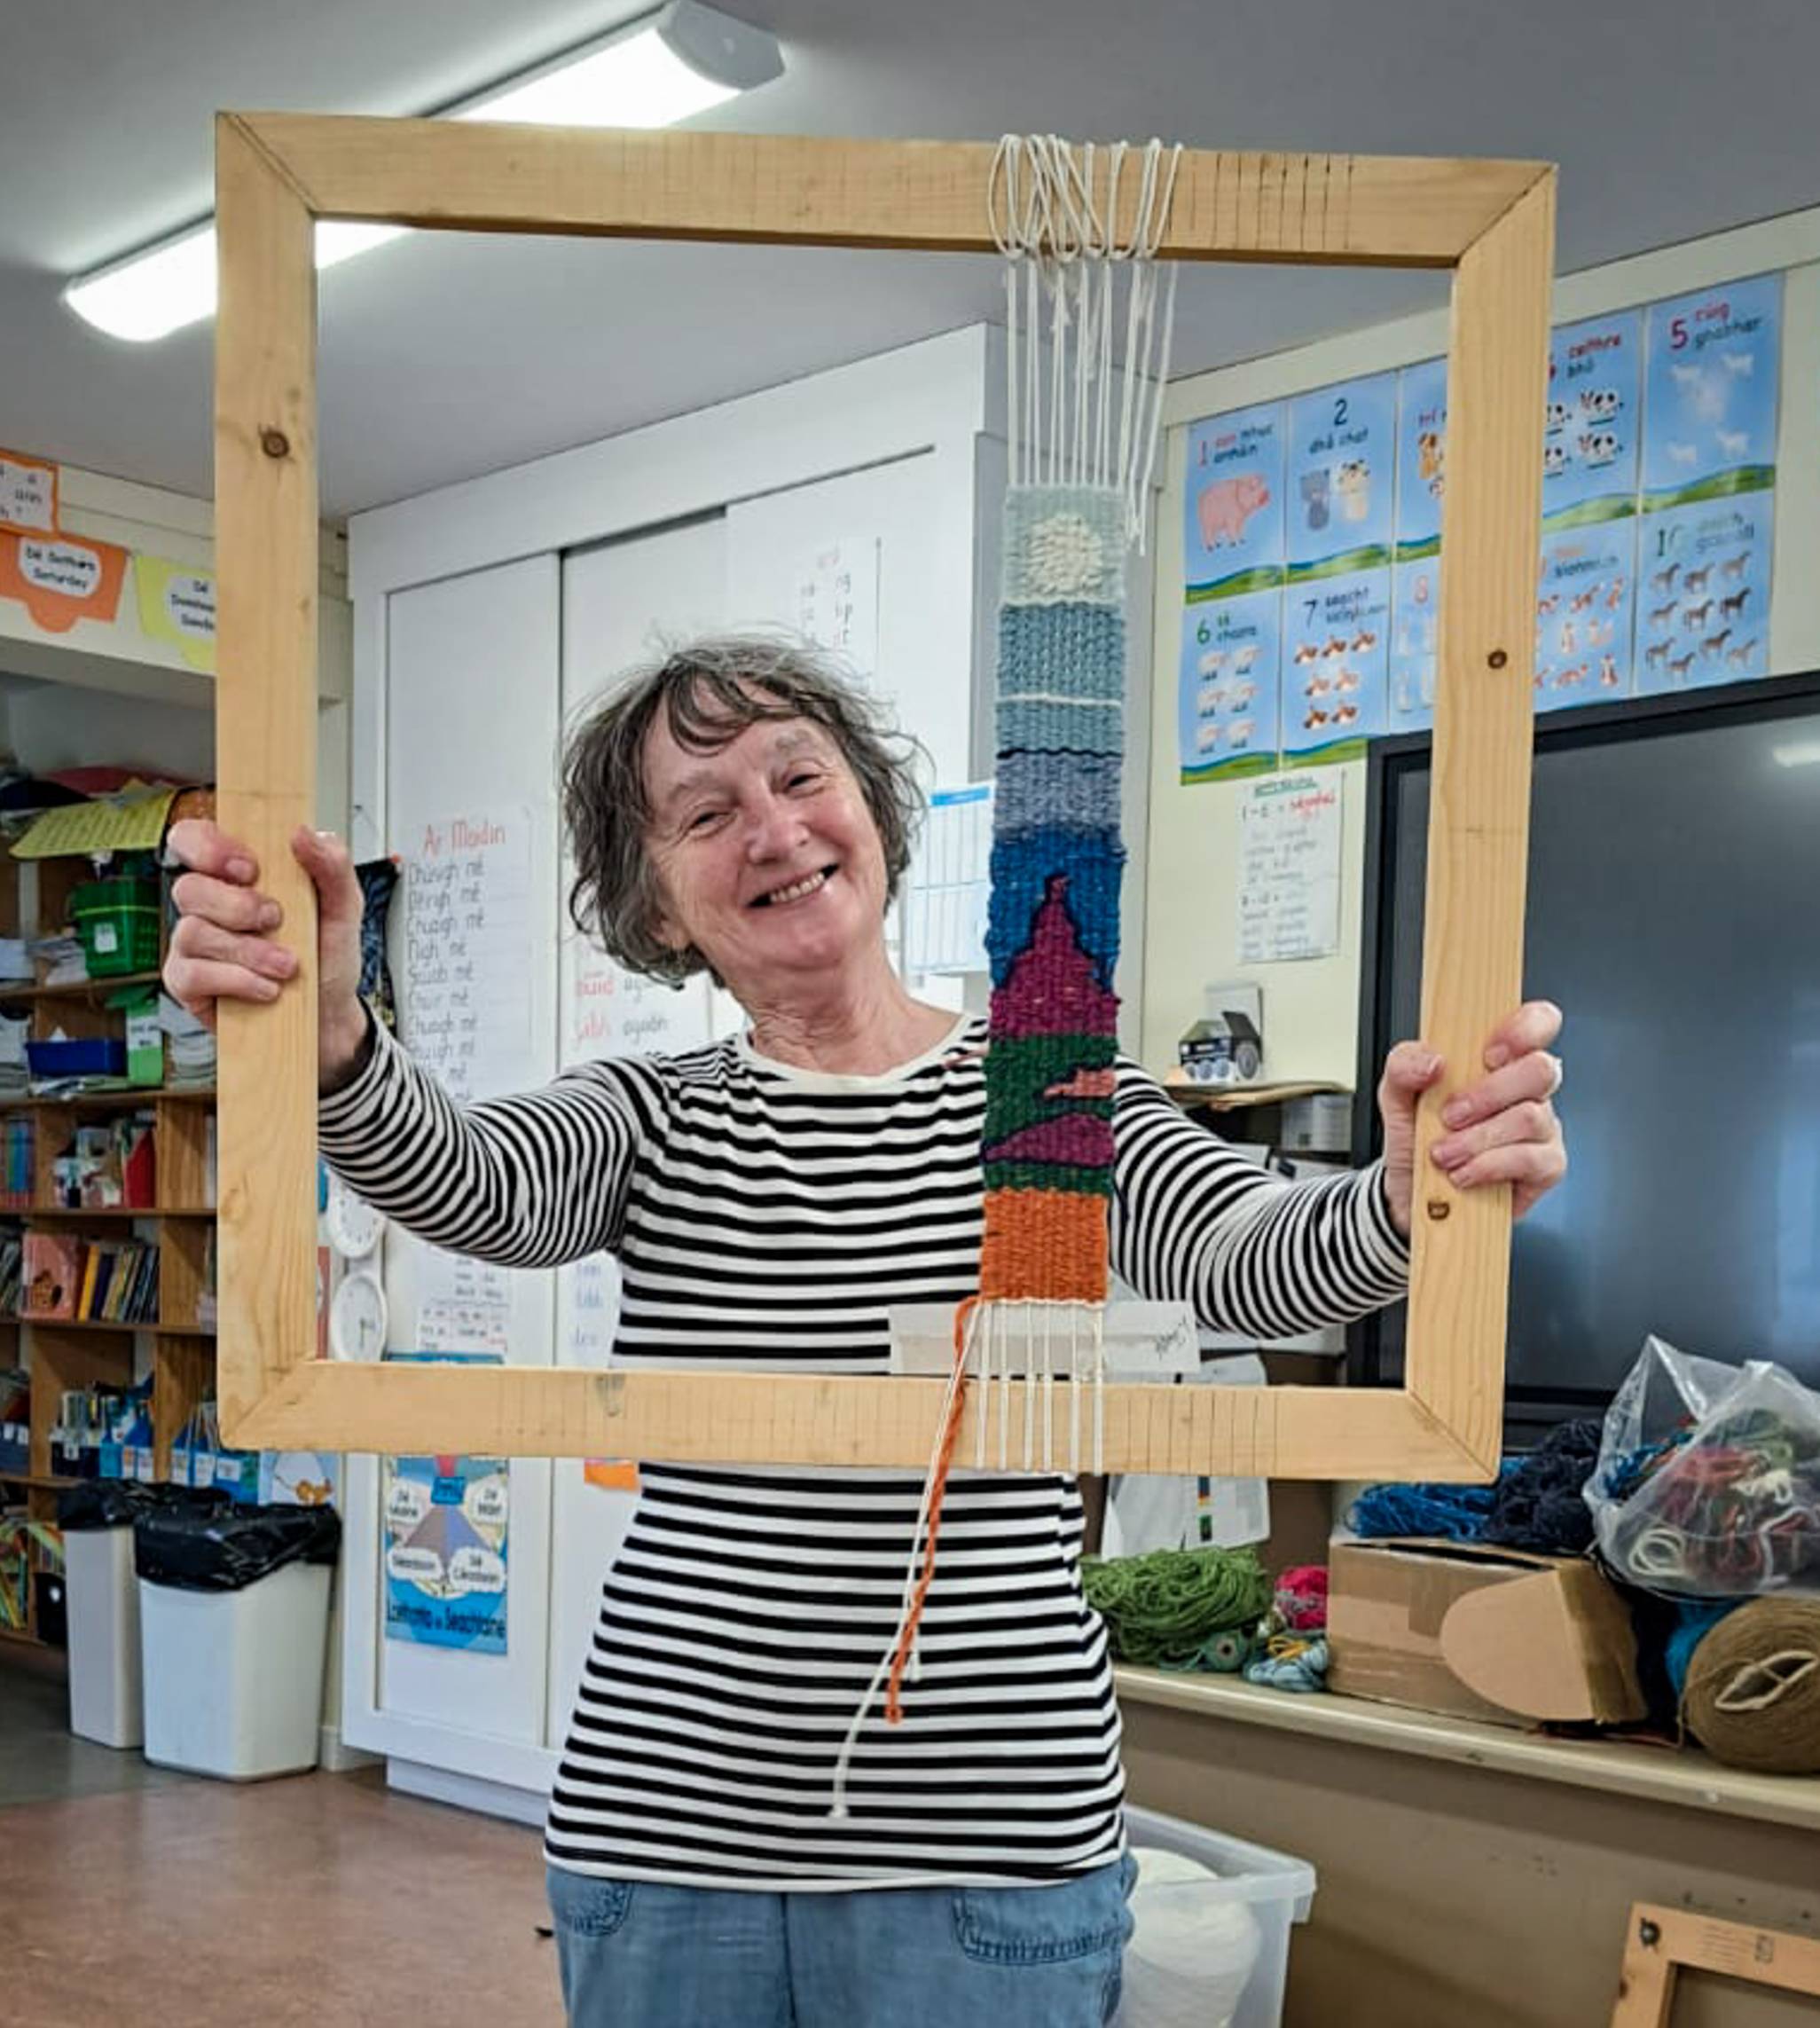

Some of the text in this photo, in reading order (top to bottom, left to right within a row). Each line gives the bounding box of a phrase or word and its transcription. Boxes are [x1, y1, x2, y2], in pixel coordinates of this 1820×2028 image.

[1671, 318, 1688, 350] 5
[1334, 397, 1348, 427] 2
[33, 567, 88, 592] Saturday
[1304, 598, 1319, 629] 7
[1197, 616, 1212, 646] 6
